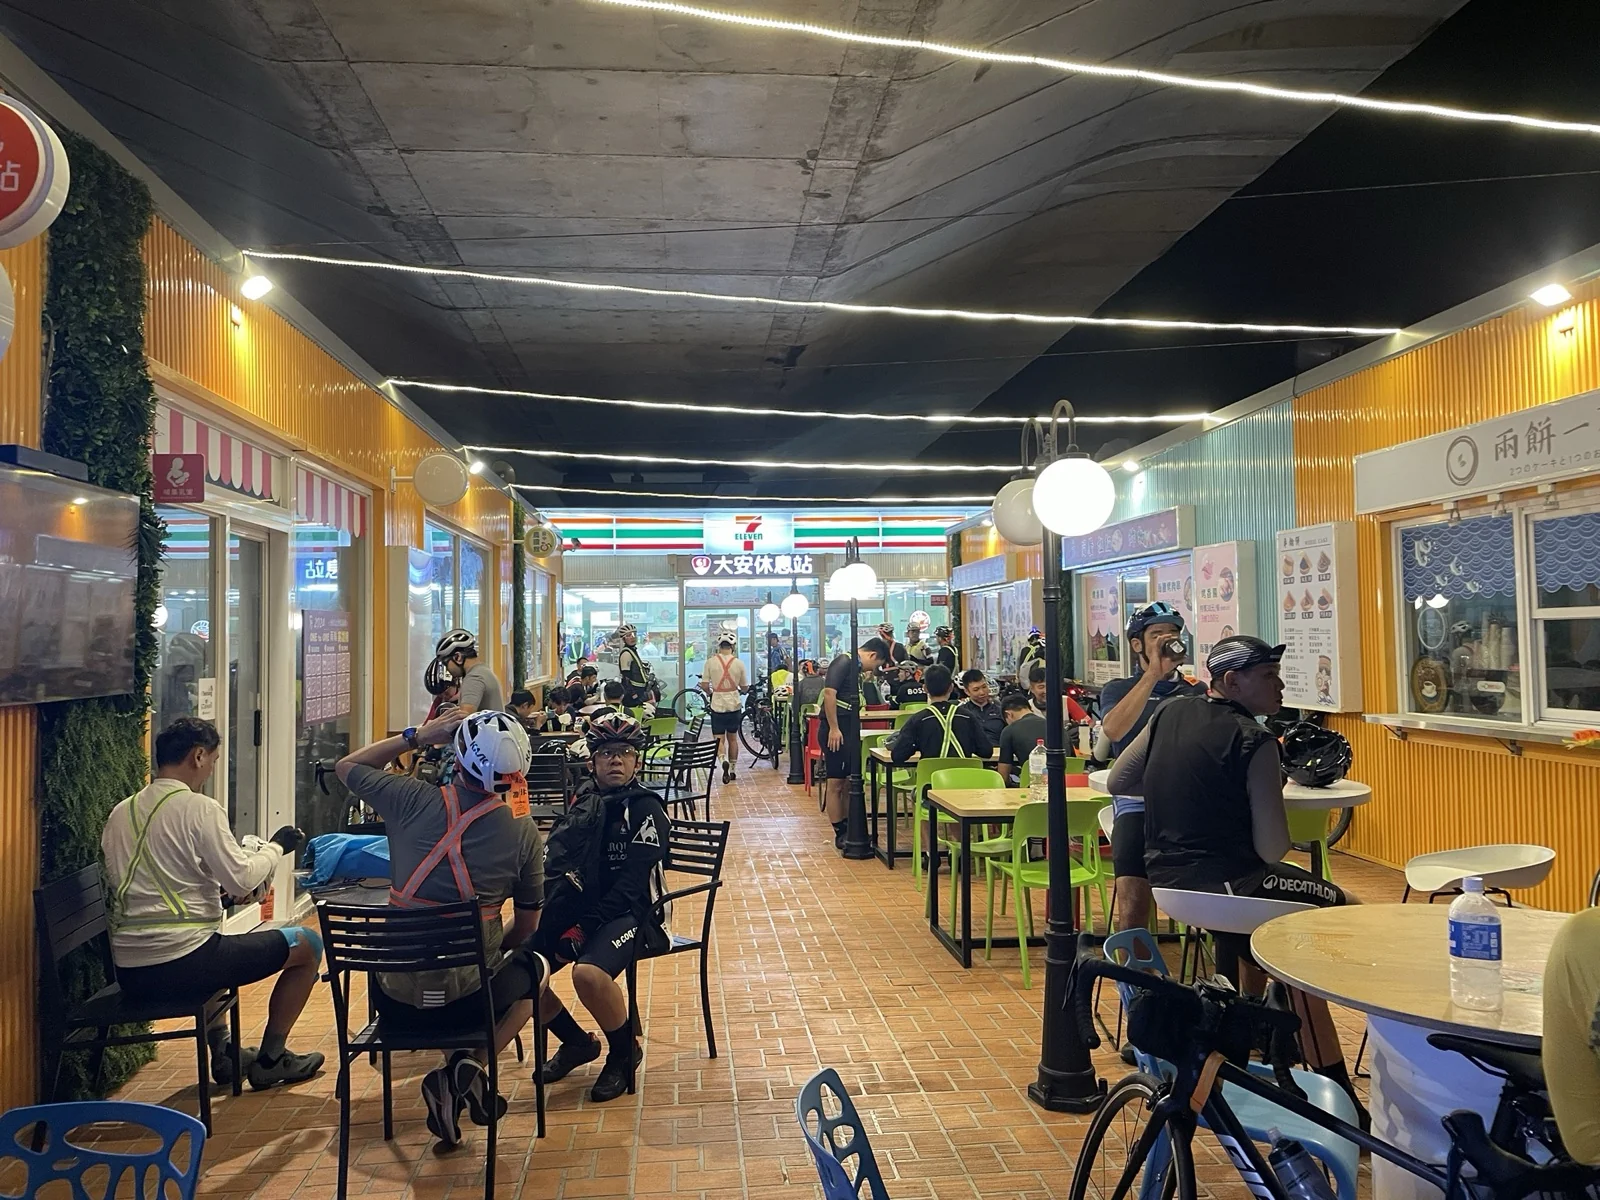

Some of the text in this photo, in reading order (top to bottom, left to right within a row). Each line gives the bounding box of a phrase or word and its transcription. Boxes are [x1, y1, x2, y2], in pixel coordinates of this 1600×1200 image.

[1493, 407, 1600, 462] 兩餅一
[735, 515, 762, 551] 7
[713, 554, 813, 575] 大安休息站
[1280, 878, 1337, 904] DECATHLON
